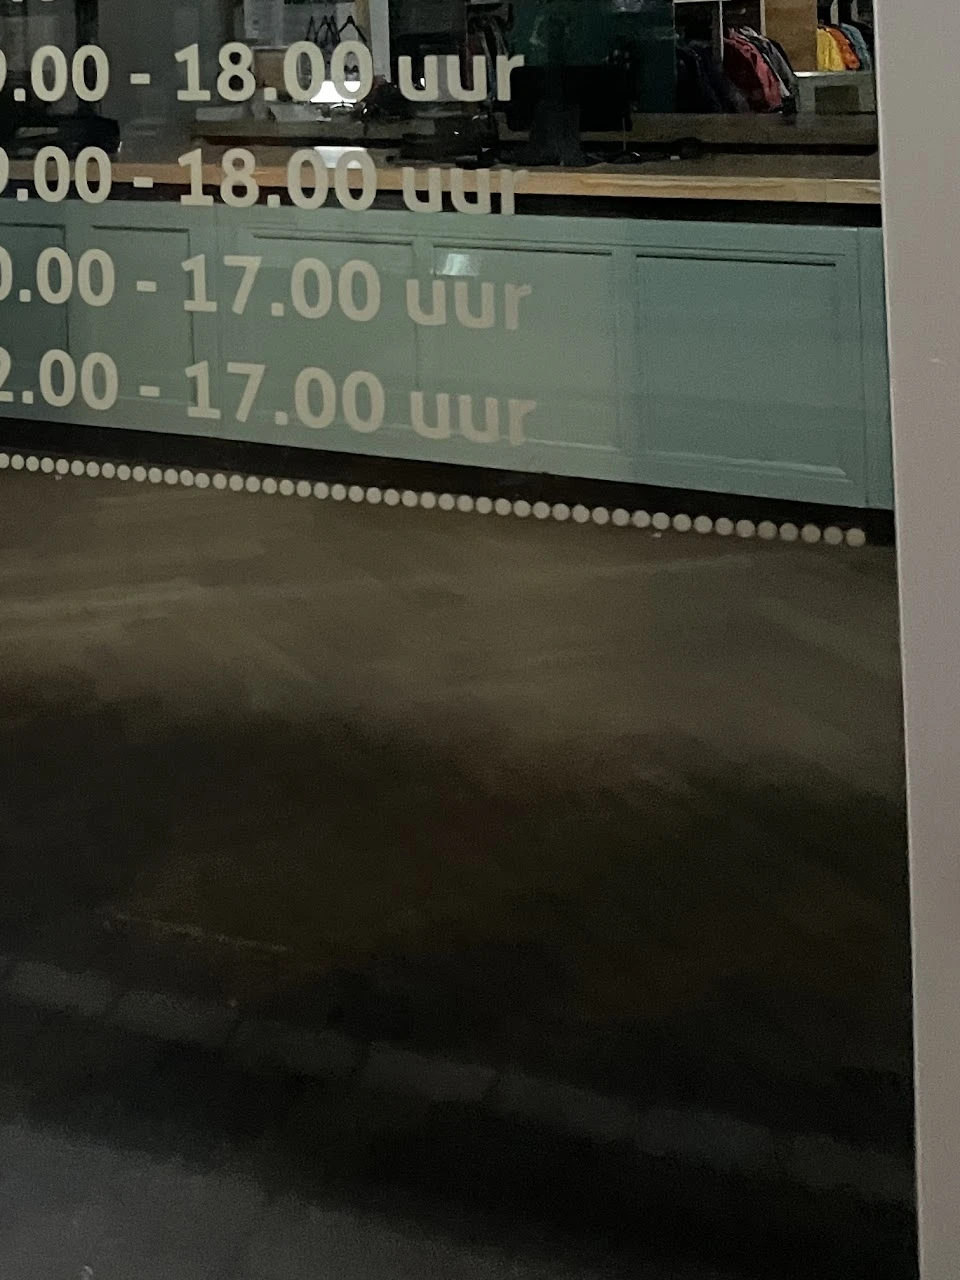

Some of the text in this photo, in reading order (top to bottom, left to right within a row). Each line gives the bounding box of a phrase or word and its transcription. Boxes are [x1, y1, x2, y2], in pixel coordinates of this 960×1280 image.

[129, 71, 151, 84] -
[174, 40, 374, 104] 18.00
[397, 51, 526, 103] uur
[132, 175, 154, 187] -
[177, 148, 378, 212] 18.00
[401, 164, 528, 217] uur
[136, 279, 158, 291] -
[181, 255, 382, 323] 17.00
[405, 277, 533, 331] uur
[139, 385, 161, 397] -
[185, 361, 386, 434] 17.00
[409, 388, 537, 447] uur
